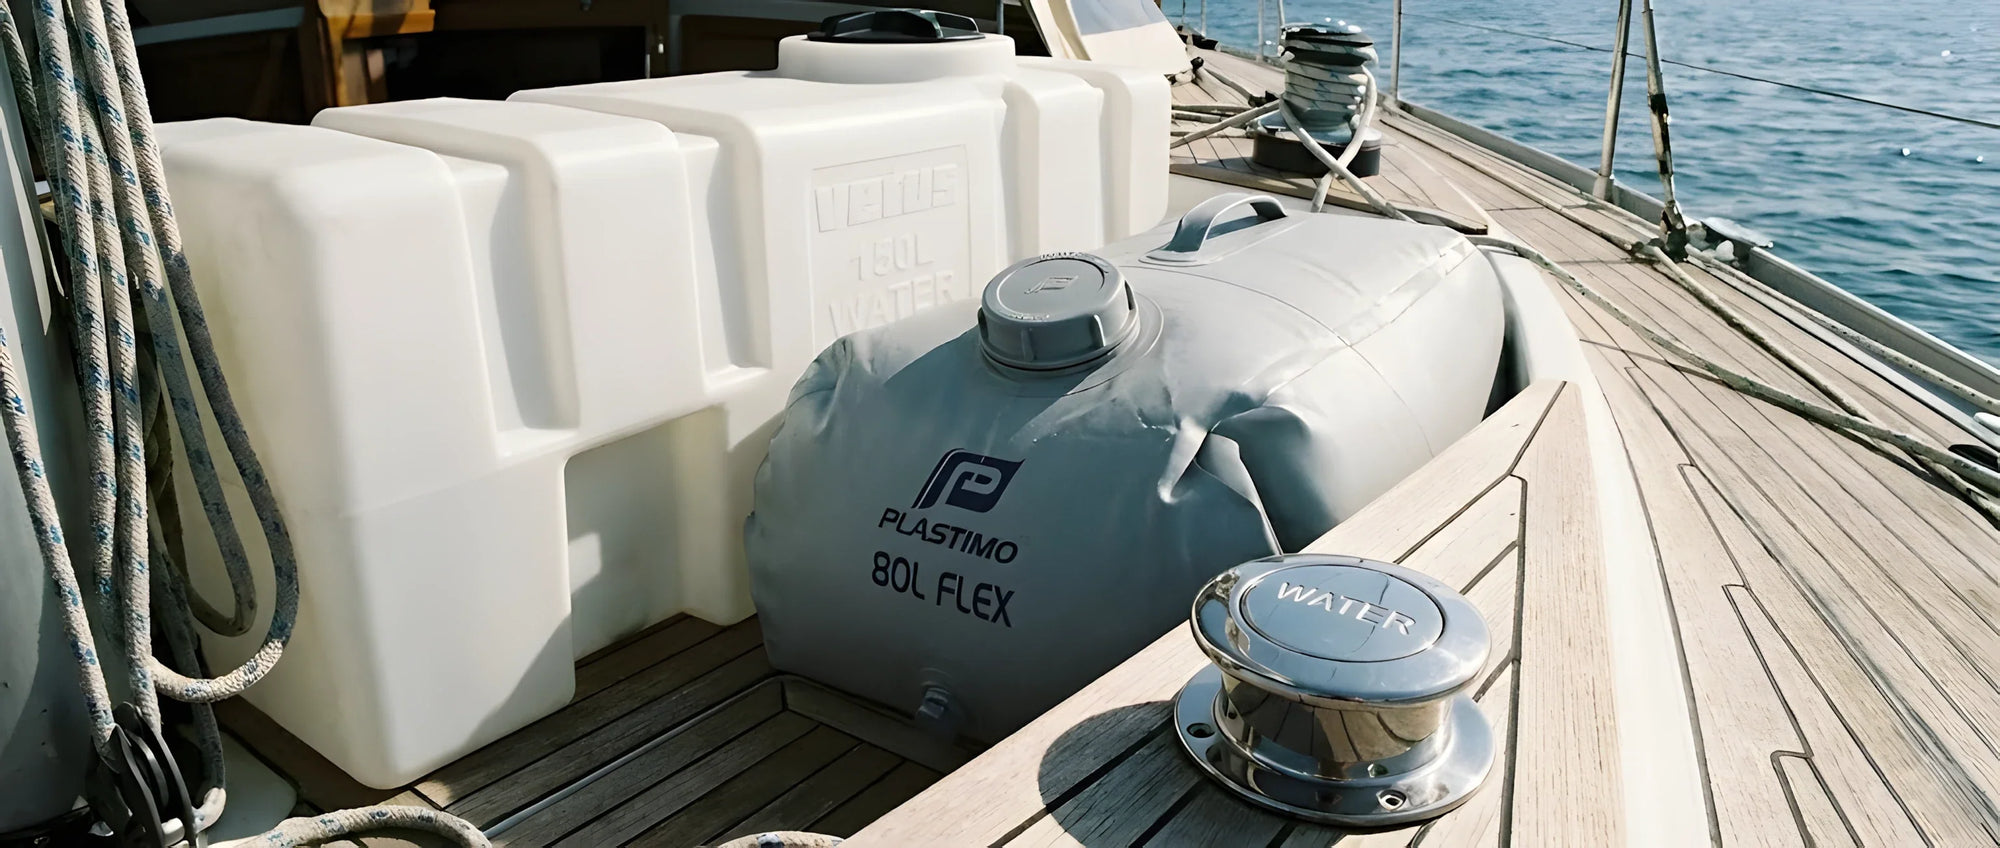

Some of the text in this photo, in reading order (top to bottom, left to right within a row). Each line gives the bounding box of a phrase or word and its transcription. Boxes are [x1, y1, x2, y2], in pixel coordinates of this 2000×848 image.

[828, 269, 955, 339] WATER
[878, 507, 1018, 564] PLASTIMO
[872, 551, 1015, 628] 80L FLEX
[1276, 581, 1417, 636] WATER
